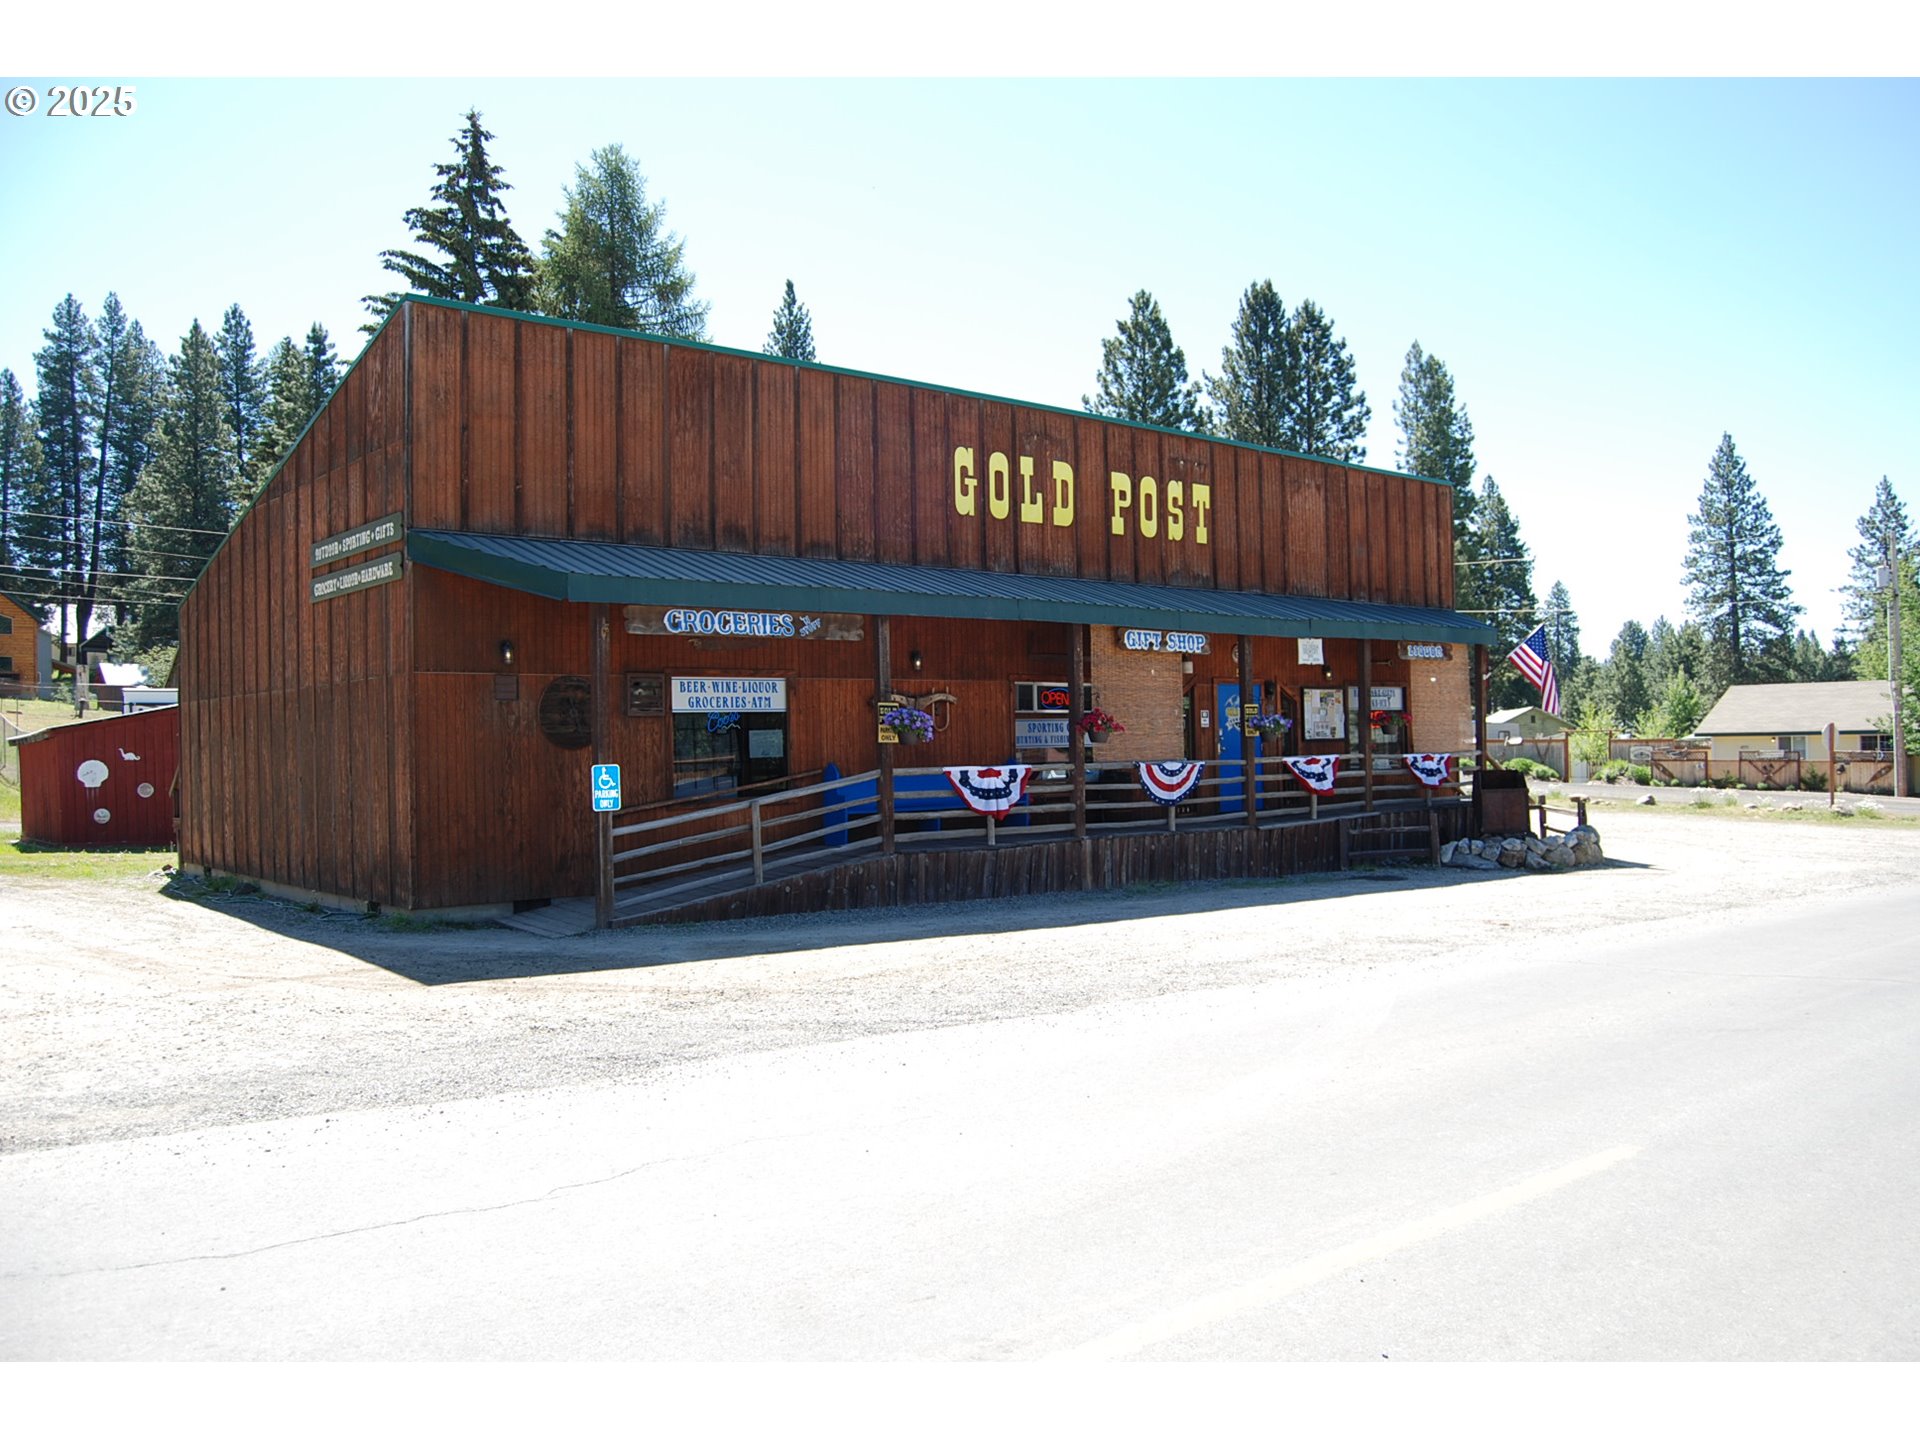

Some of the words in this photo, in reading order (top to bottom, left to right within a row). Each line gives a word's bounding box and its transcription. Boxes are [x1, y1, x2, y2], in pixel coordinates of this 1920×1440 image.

[954, 446, 1075, 527] GOLD
[1111, 471, 1211, 544] POST
[342, 530, 371, 552] SPORTING
[374, 522, 395, 541] GIFTS
[313, 578, 337, 597] GROCERY
[361, 561, 394, 583] HARDWARE
[664, 608, 796, 637] GROCERIES
[1124, 629, 1162, 651] GIFT
[1166, 632, 1206, 653] SHOP
[1407, 645, 1443, 658] LIQUOR
[679, 681, 707, 693] BEER
[711, 681, 738, 694] WINE
[742, 682, 778, 694] LIQUOR
[688, 696, 747, 708] GROCERIES
[751, 697, 772, 708] ATM
[1041, 690, 1071, 705] OPEN
[1027, 722, 1064, 733] SPORTING
[595, 789, 619, 799] PARKING
[600, 799, 614, 808] ONLY
